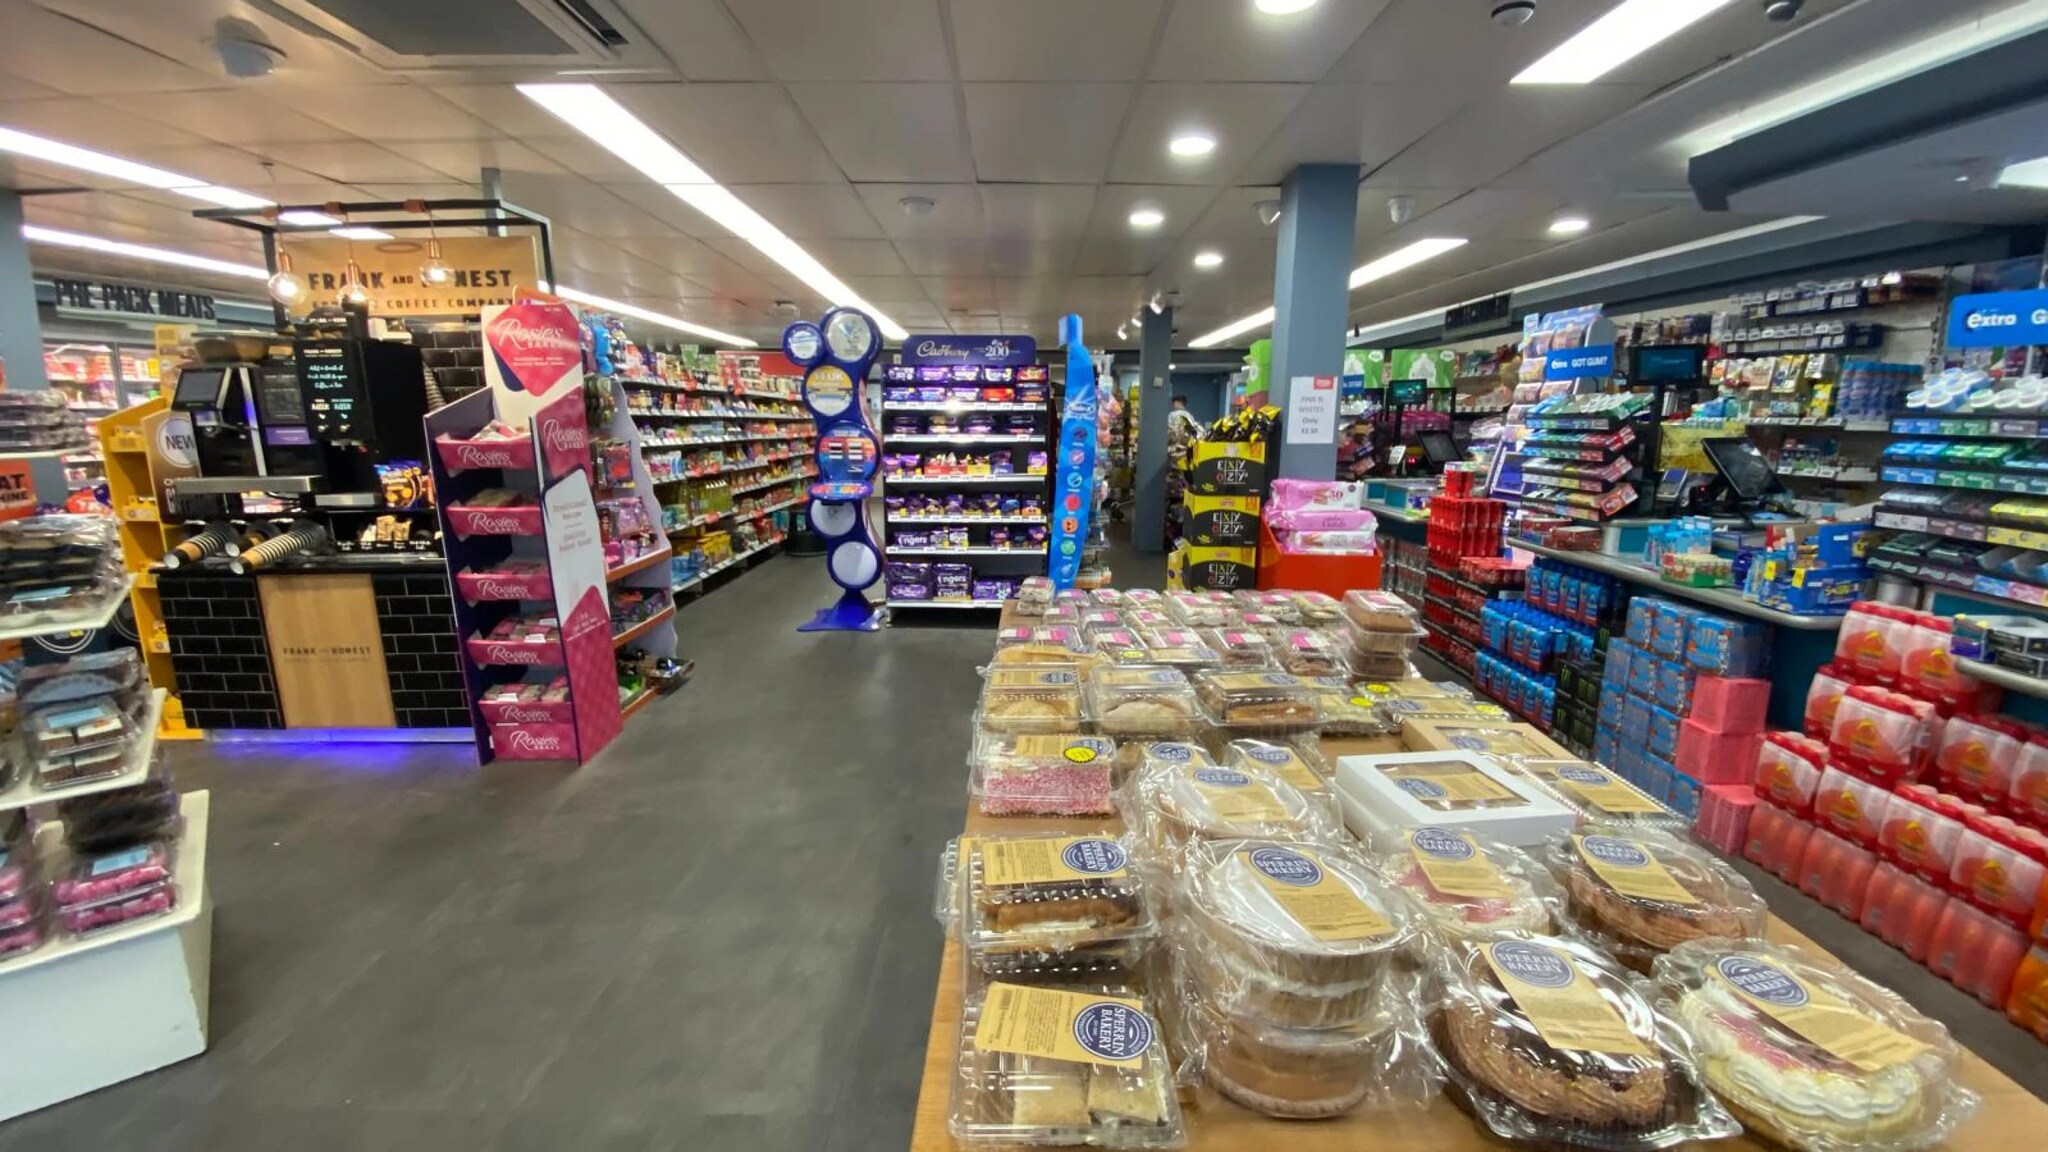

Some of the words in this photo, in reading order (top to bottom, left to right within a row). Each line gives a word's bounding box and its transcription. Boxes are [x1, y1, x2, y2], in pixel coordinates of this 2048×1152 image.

[392, 275, 414, 285] AND
[157, 289, 217, 321] MEATS
[386, 298, 440, 309] COFFEE
[1966, 312, 2018, 329] extra
[916, 339, 970, 361] Cadbury
[984, 344, 1010, 358] 200
[1571, 357, 1587, 368] GOT
[165, 433, 196, 450] NEW
[544, 418, 584, 452] Rosies
[457, 444, 511, 468] Rosies
[468, 511, 521, 534] Rosies
[477, 579, 530, 599] Rosies
[283, 647, 317, 655] FRANK
[331, 646, 371, 655] HONEST
[487, 644, 538, 664] Rosies
[500, 704, 551, 723] Rosies
[510, 730, 560, 751] Rosies
[1080, 843, 1099, 870] BAKERY
[1090, 840, 1110, 872] SPERRIN
[1256, 858, 1311, 868] SPERRIN
[1265, 866, 1313, 875] BAKERY
[1498, 952, 1562, 965] SPERRIN
[1505, 963, 1562, 974] BAKERY
[1729, 969, 1781, 985] SPERRIN
[1744, 977, 1793, 993] BAKERY
[1099, 1008, 1113, 1051] BAKERY
[1112, 1006, 1126, 1056] SPERRIN
